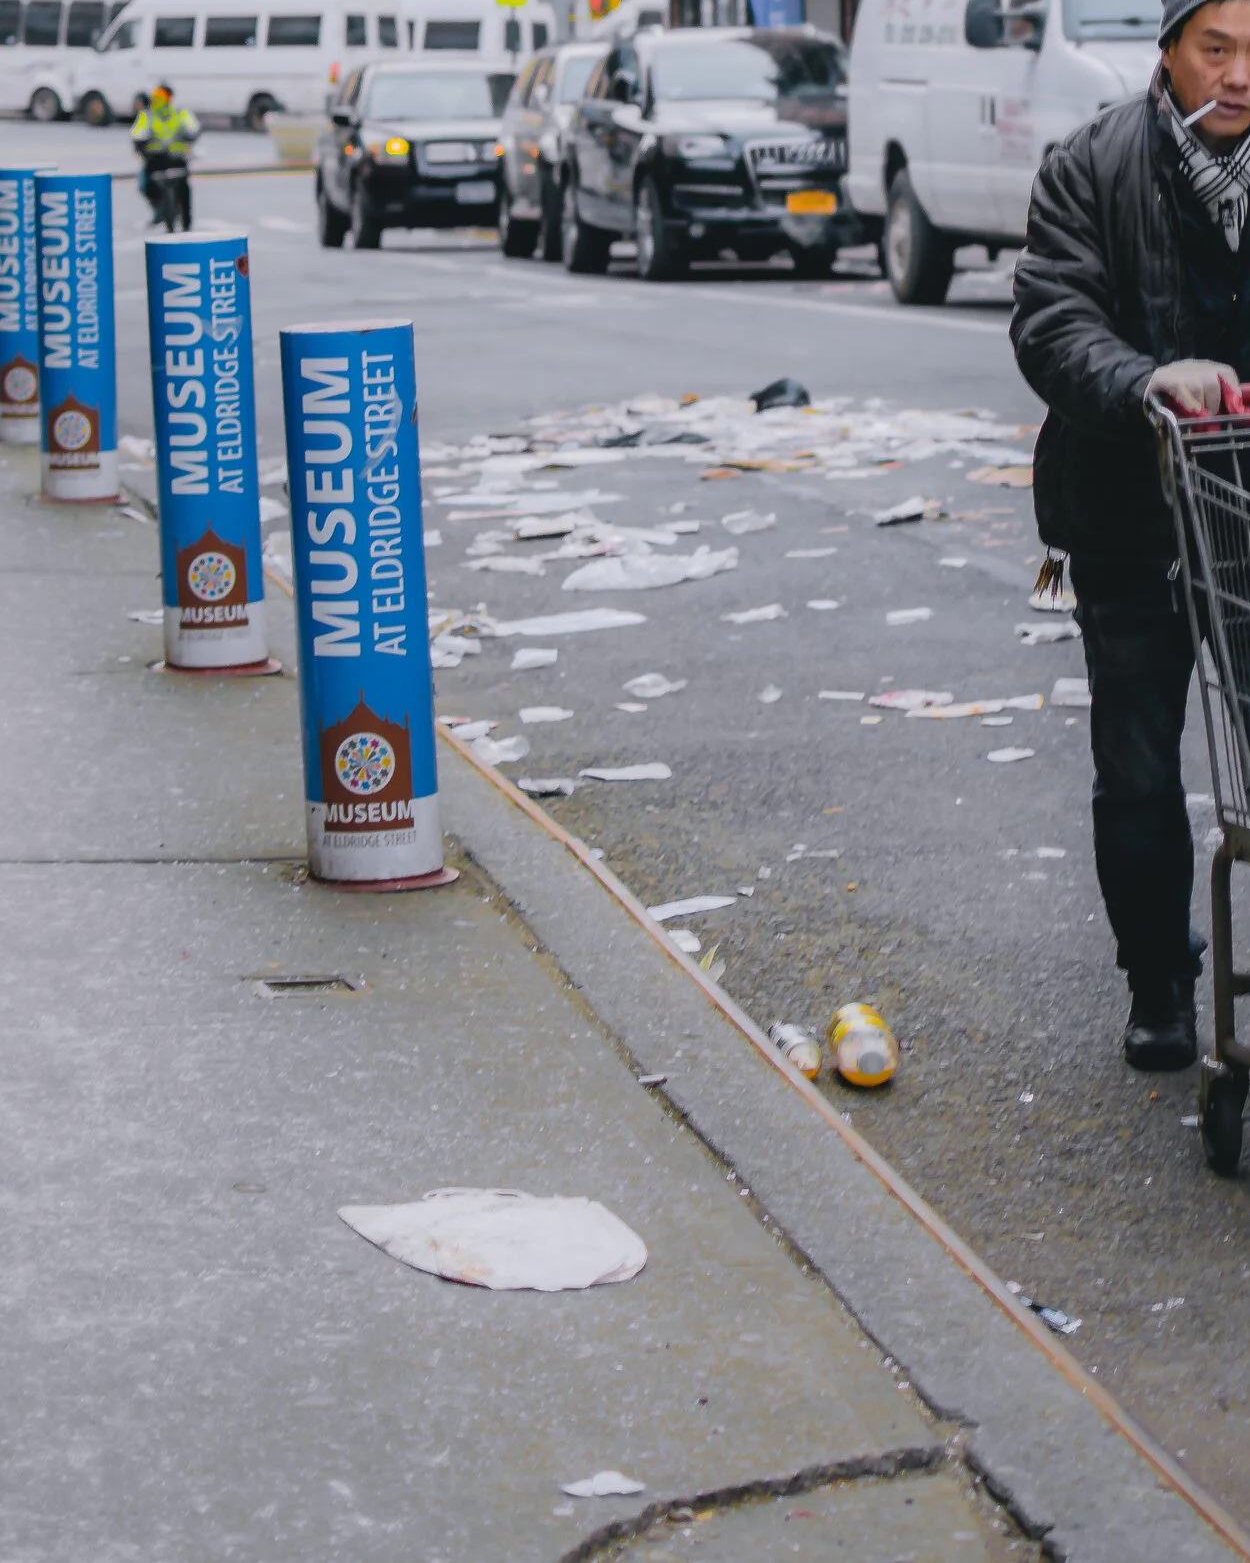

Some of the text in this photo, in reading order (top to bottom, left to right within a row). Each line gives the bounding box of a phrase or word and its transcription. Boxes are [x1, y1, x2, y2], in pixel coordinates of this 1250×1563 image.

[41, 191, 72, 368] MUSEUM
[74, 189, 99, 369] AT ELDRIDGE STREET
[162, 262, 209, 495] MUSEUM
[209, 257, 243, 494] AT ELDRIDGE STREET
[300, 356, 361, 657] MUSEUM
[361, 350, 407, 656] AT ELDRIDGE STREET
[181, 604, 248, 623] MUSEUM
[325, 800, 414, 824] MUSEUM
[334, 833, 379, 849] ELDRIDGE
[384, 830, 416, 846] STREET
